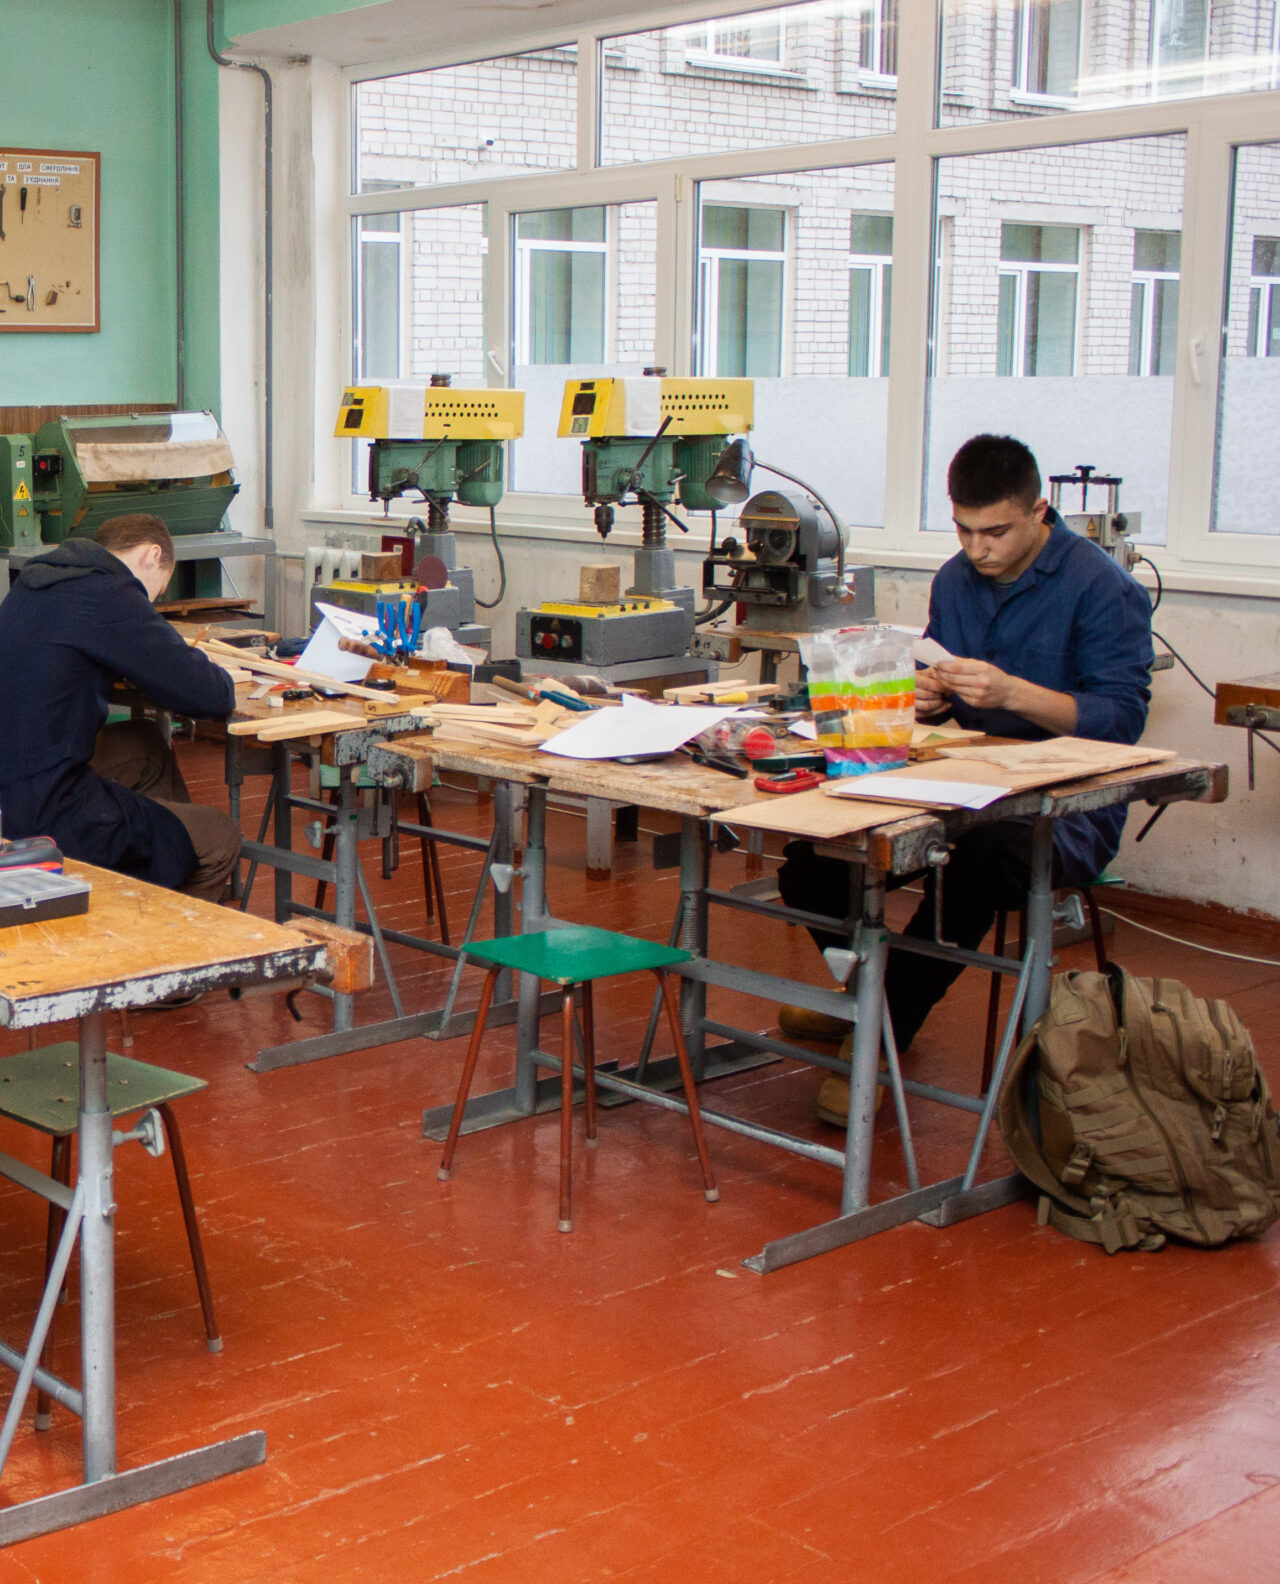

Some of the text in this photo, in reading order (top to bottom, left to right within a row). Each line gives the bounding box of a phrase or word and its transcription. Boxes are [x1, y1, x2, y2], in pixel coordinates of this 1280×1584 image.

[18, 163, 31, 171] ДЛЯ
[41, 164, 79, 172] СВЕРДЛІННЯ
[18, 445, 25, 457] 5
